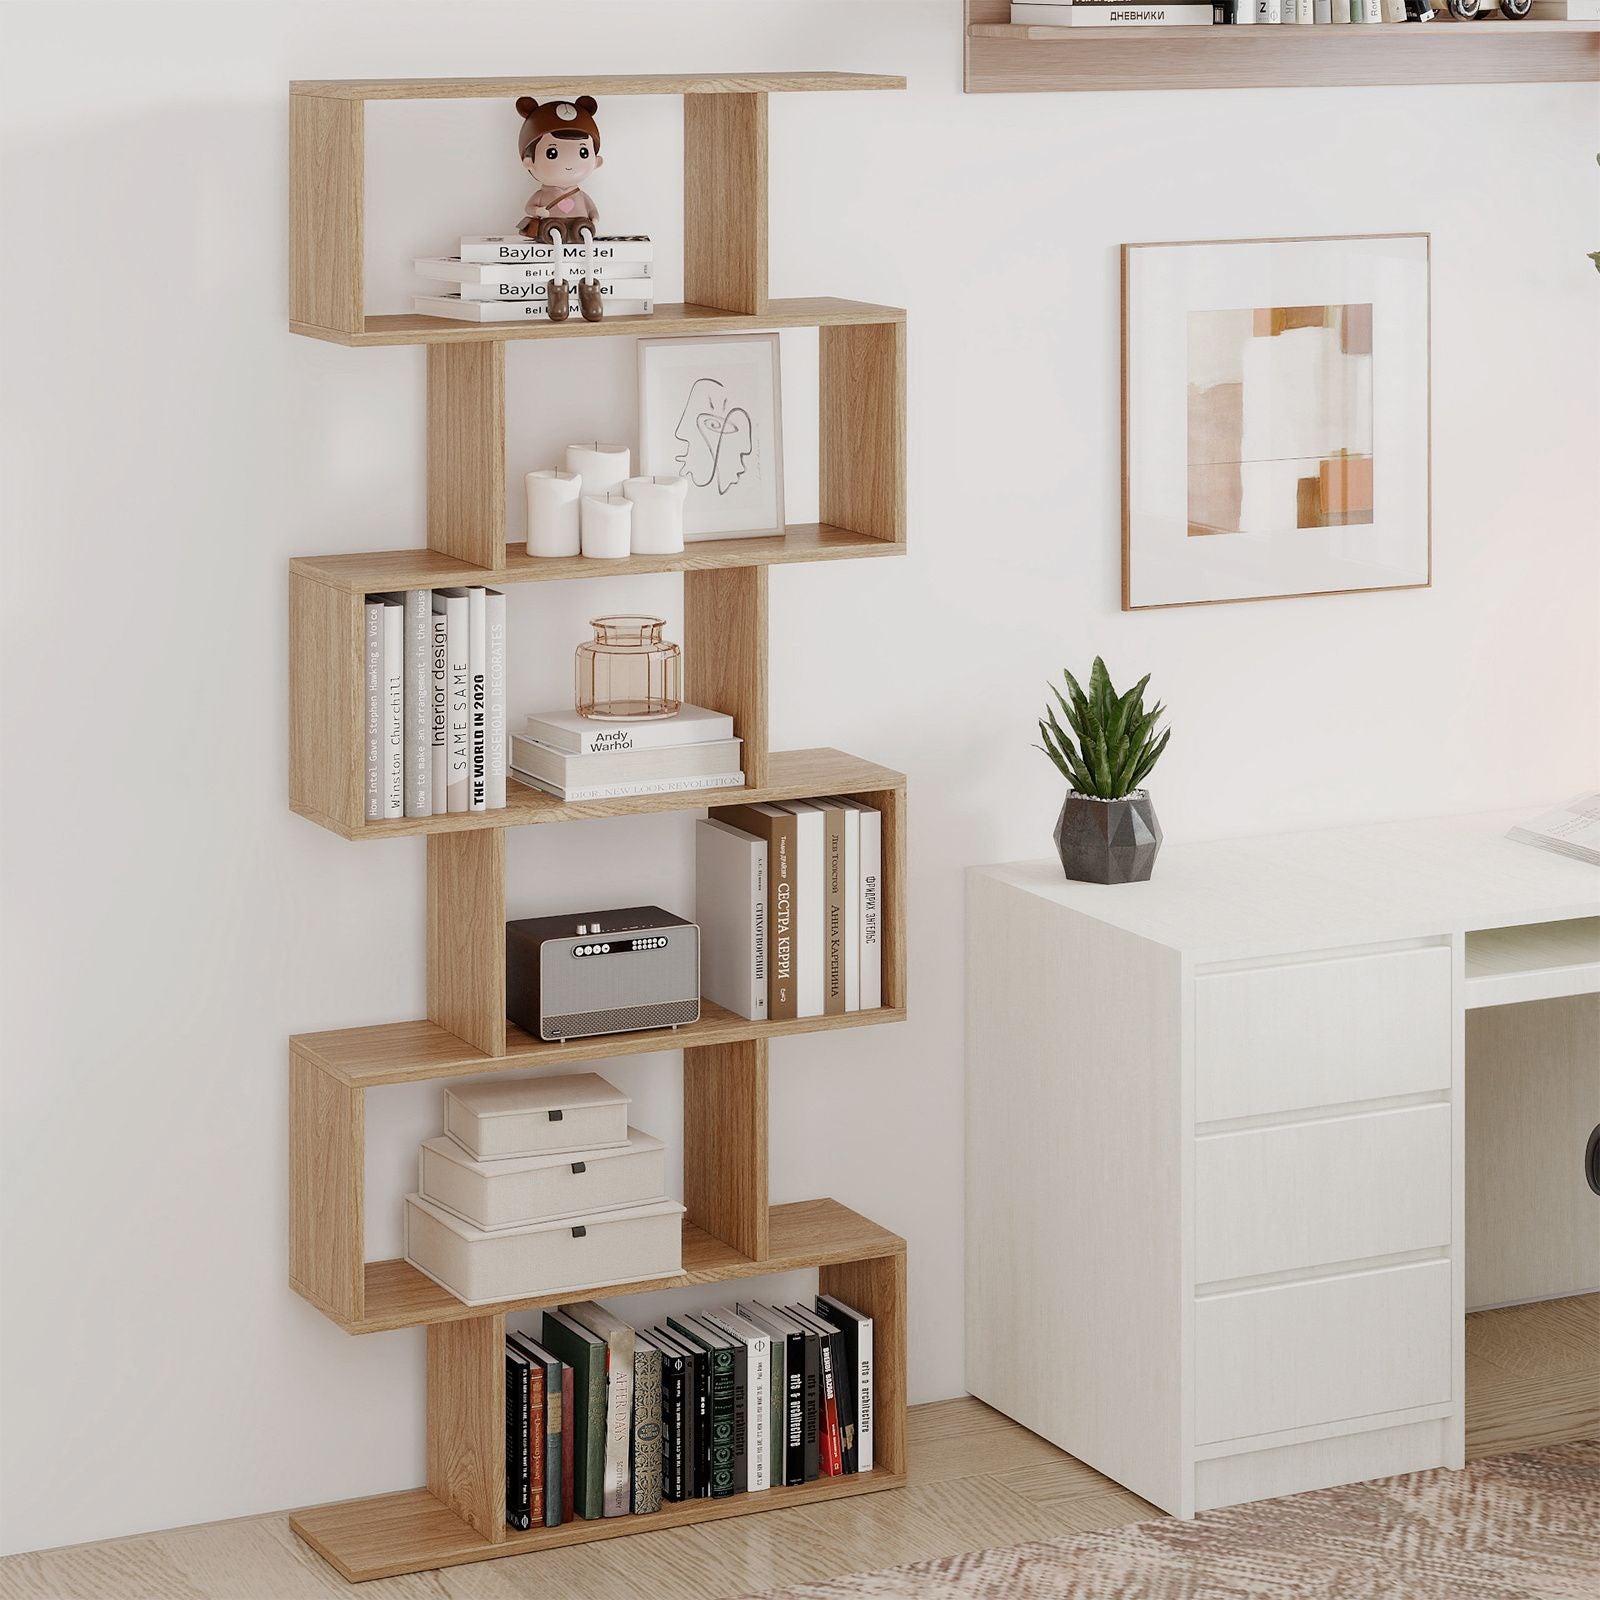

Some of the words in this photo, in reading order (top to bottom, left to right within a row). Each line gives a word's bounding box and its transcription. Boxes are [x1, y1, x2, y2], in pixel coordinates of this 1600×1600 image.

[1110, 11, 1165, 21] ДНЕВНИКИ
[499, 246, 554, 261] Baylor
[525, 269, 542, 277] Bel
[569, 267, 603, 275] Moel
[499, 283, 546, 298] Baylo
[525, 306, 542, 315] Bel
[415, 590, 426, 619] house
[368, 609, 378, 637] Voice
[416, 623, 426, 640] the
[416, 645, 426, 657] in
[431, 622, 448, 680] design
[491, 623, 503, 696] DECORATES
[369, 651, 380, 691] Hawking
[453, 662, 467, 711] SAME
[417, 662, 428, 724] arrangement
[473, 674, 485, 709] 2020
[369, 695, 379, 734] Stephen
[390, 675, 401, 745] Churchill
[431, 684, 445, 747] Interior
[473, 712, 485, 727] IN
[418, 728, 426, 741] an
[453, 721, 467, 770] SAME
[492, 703, 503, 776] HOUSEHOLD
[589, 739, 634, 753] Warhol
[595, 730, 628, 743] Andy
[369, 739, 378, 762] Gave
[416, 746, 426, 769] make
[473, 729, 485, 778] WORLD
[369, 766, 378, 793] Intel
[390, 753, 401, 809] Winston
[416, 774, 426, 785] to
[473, 780, 485, 805] THE
[369, 798, 378, 816] How
[416, 790, 426, 808] How
[777, 882, 790, 934] СЕСТРА
[865, 876, 876, 911] ФРИДРИХ
[831, 904, 840, 938] АННА
[754, 902, 764, 980] СТИХОТВОРЕНИЯ
[777, 936, 790, 979] КЕРРИ
[830, 939, 840, 998] КАРЕНИНА
[790, 1374, 802, 1390] arts
[861, 1360, 870, 1376] arts
[614, 1371, 628, 1409] AFTER
[790, 1401, 802, 1447] architecture
[861, 1387, 871, 1433] architecture
[614, 1411, 627, 1442] DAYS
